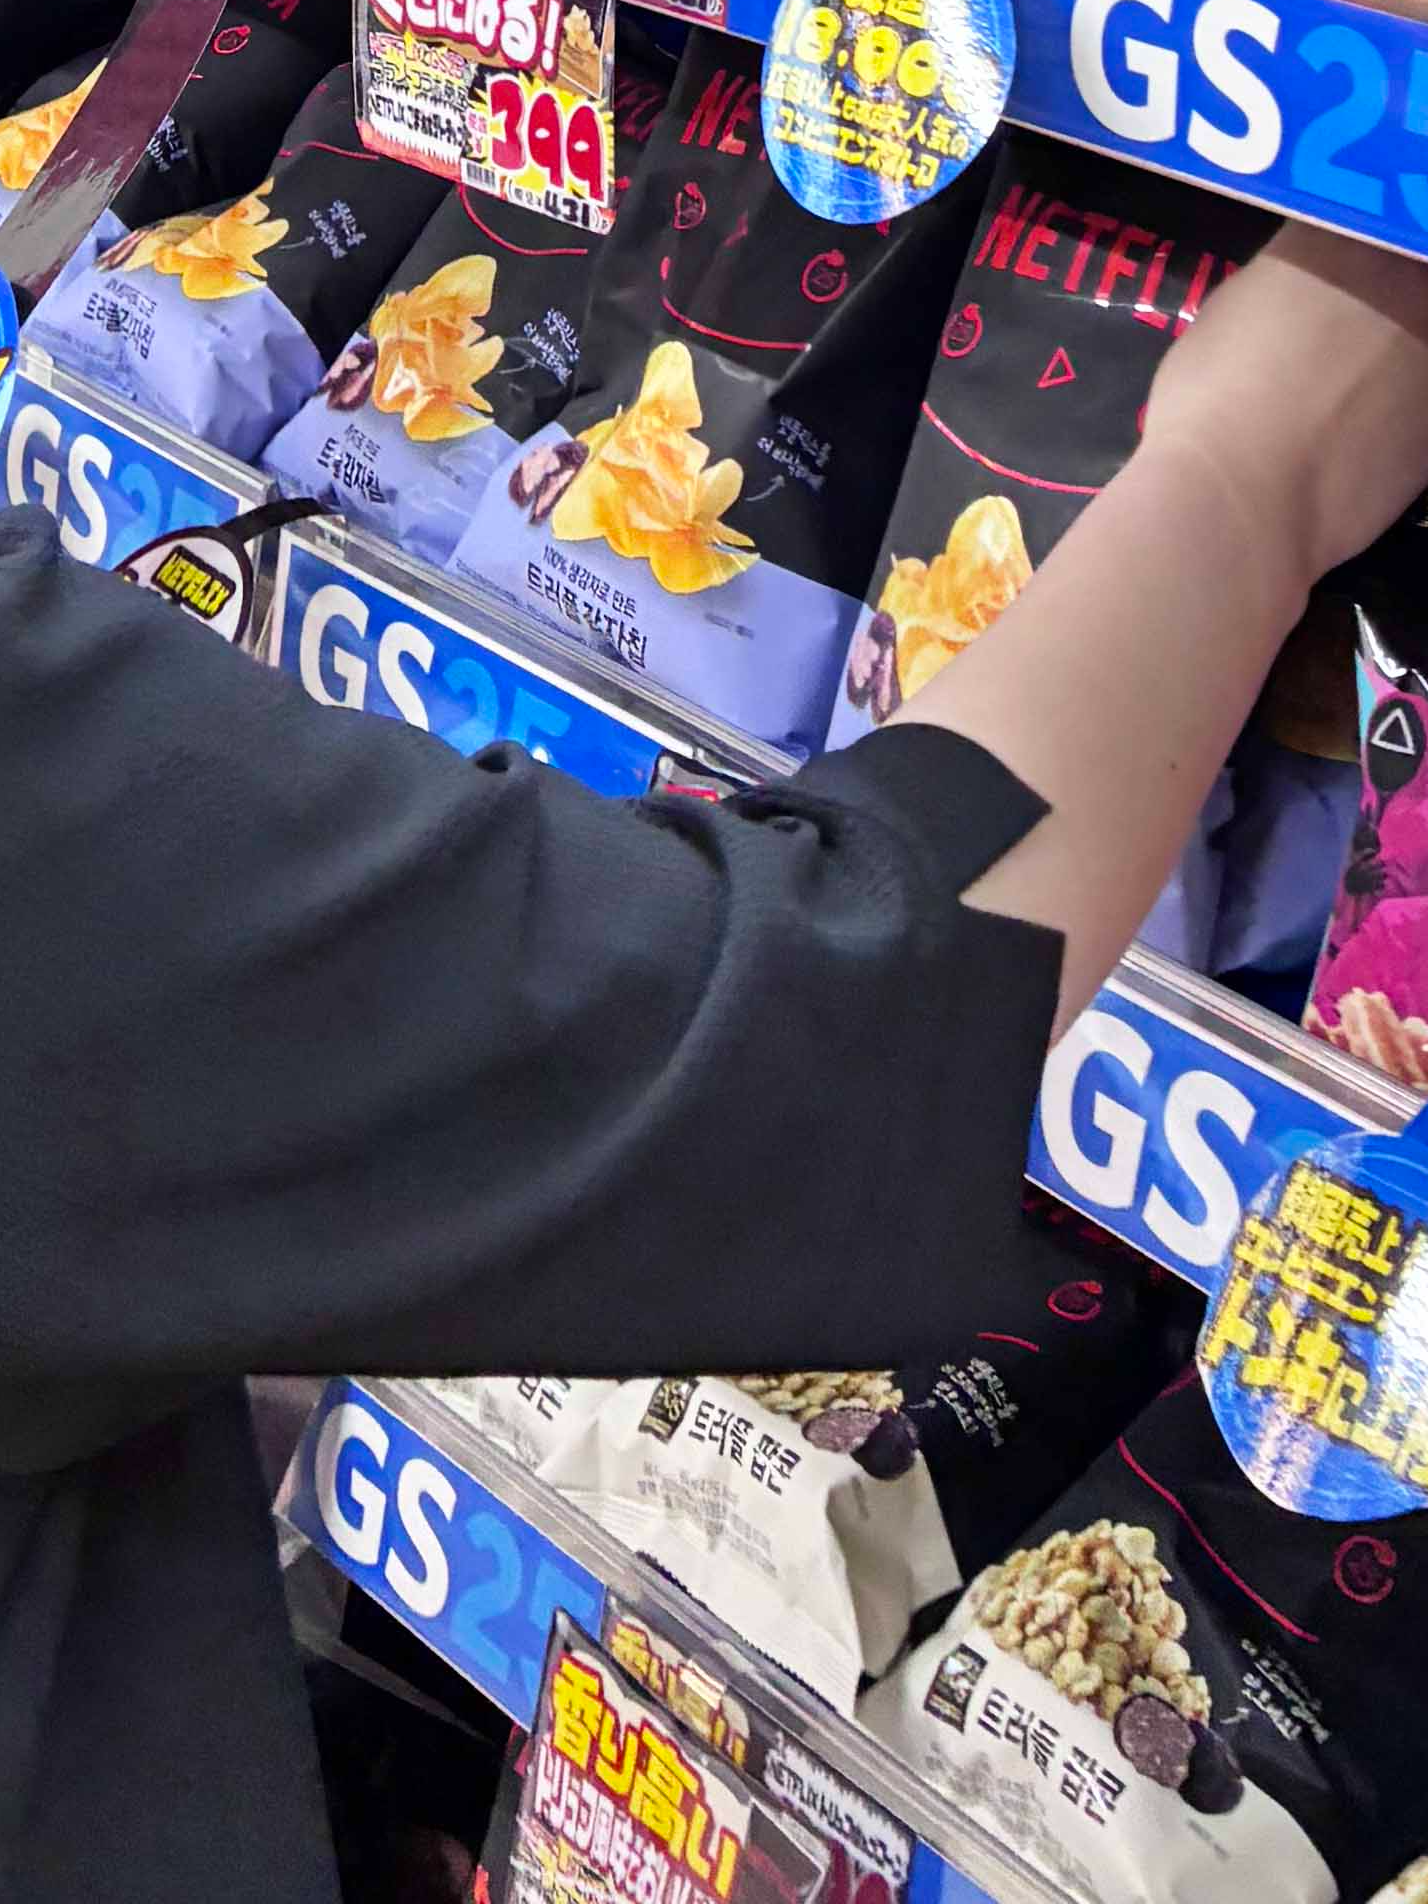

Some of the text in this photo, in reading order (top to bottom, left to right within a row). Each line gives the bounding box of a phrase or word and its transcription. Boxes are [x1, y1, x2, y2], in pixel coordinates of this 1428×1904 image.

[487, 75, 605, 205] 399
[973, 185, 1246, 338] NETFLI
[7, 404, 222, 570] GS2
[156, 549, 231, 617] NETFLIX
[1041, 1009, 1258, 1268] GS
[687, 1399, 756, 1469] 트러플
[551, 1652, 741, 1898] 香り高い
[976, 1688, 1128, 1826] 트러플 팝콘
